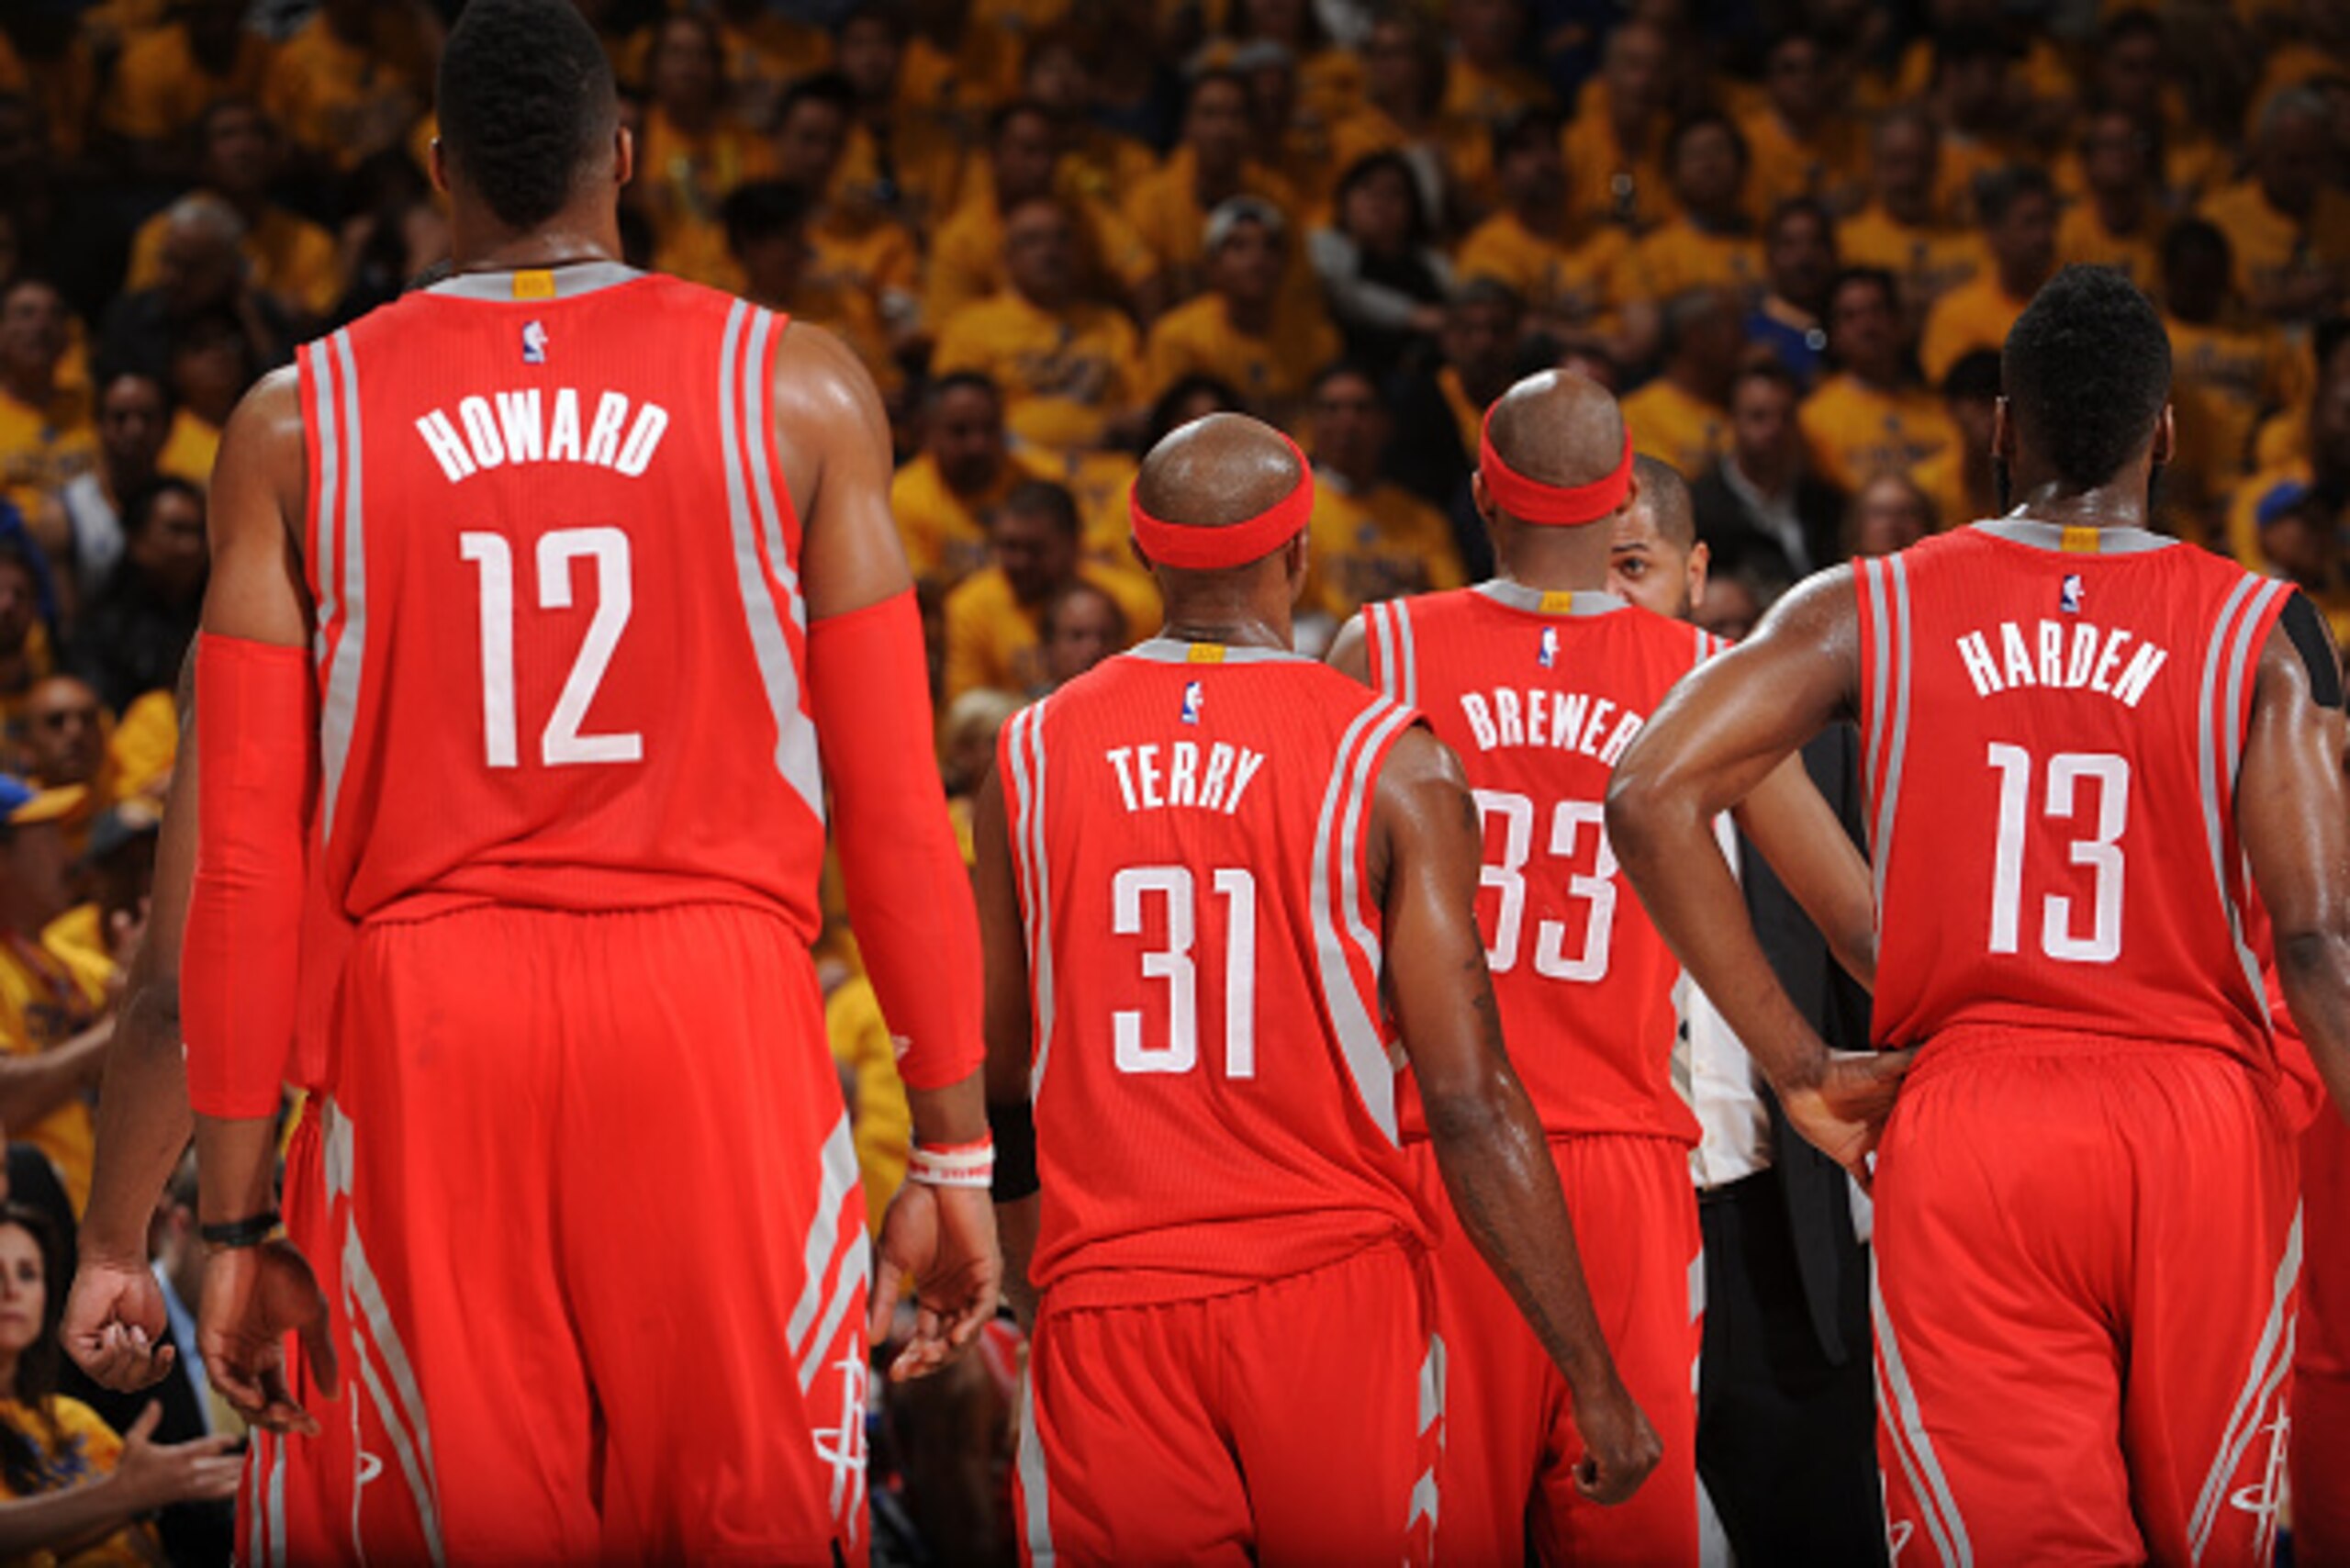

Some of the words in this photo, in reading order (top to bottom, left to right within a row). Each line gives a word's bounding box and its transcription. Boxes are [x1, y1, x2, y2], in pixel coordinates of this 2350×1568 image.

[414, 386, 669, 484] HOWARD
[460, 526, 643, 767] 12
[1956, 618, 2168, 708] HARDEN
[1460, 686, 1644, 767] BREWER
[1105, 741, 1266, 815] TERRY
[1987, 742, 2131, 963] 13
[1112, 866, 1256, 1079] 31
